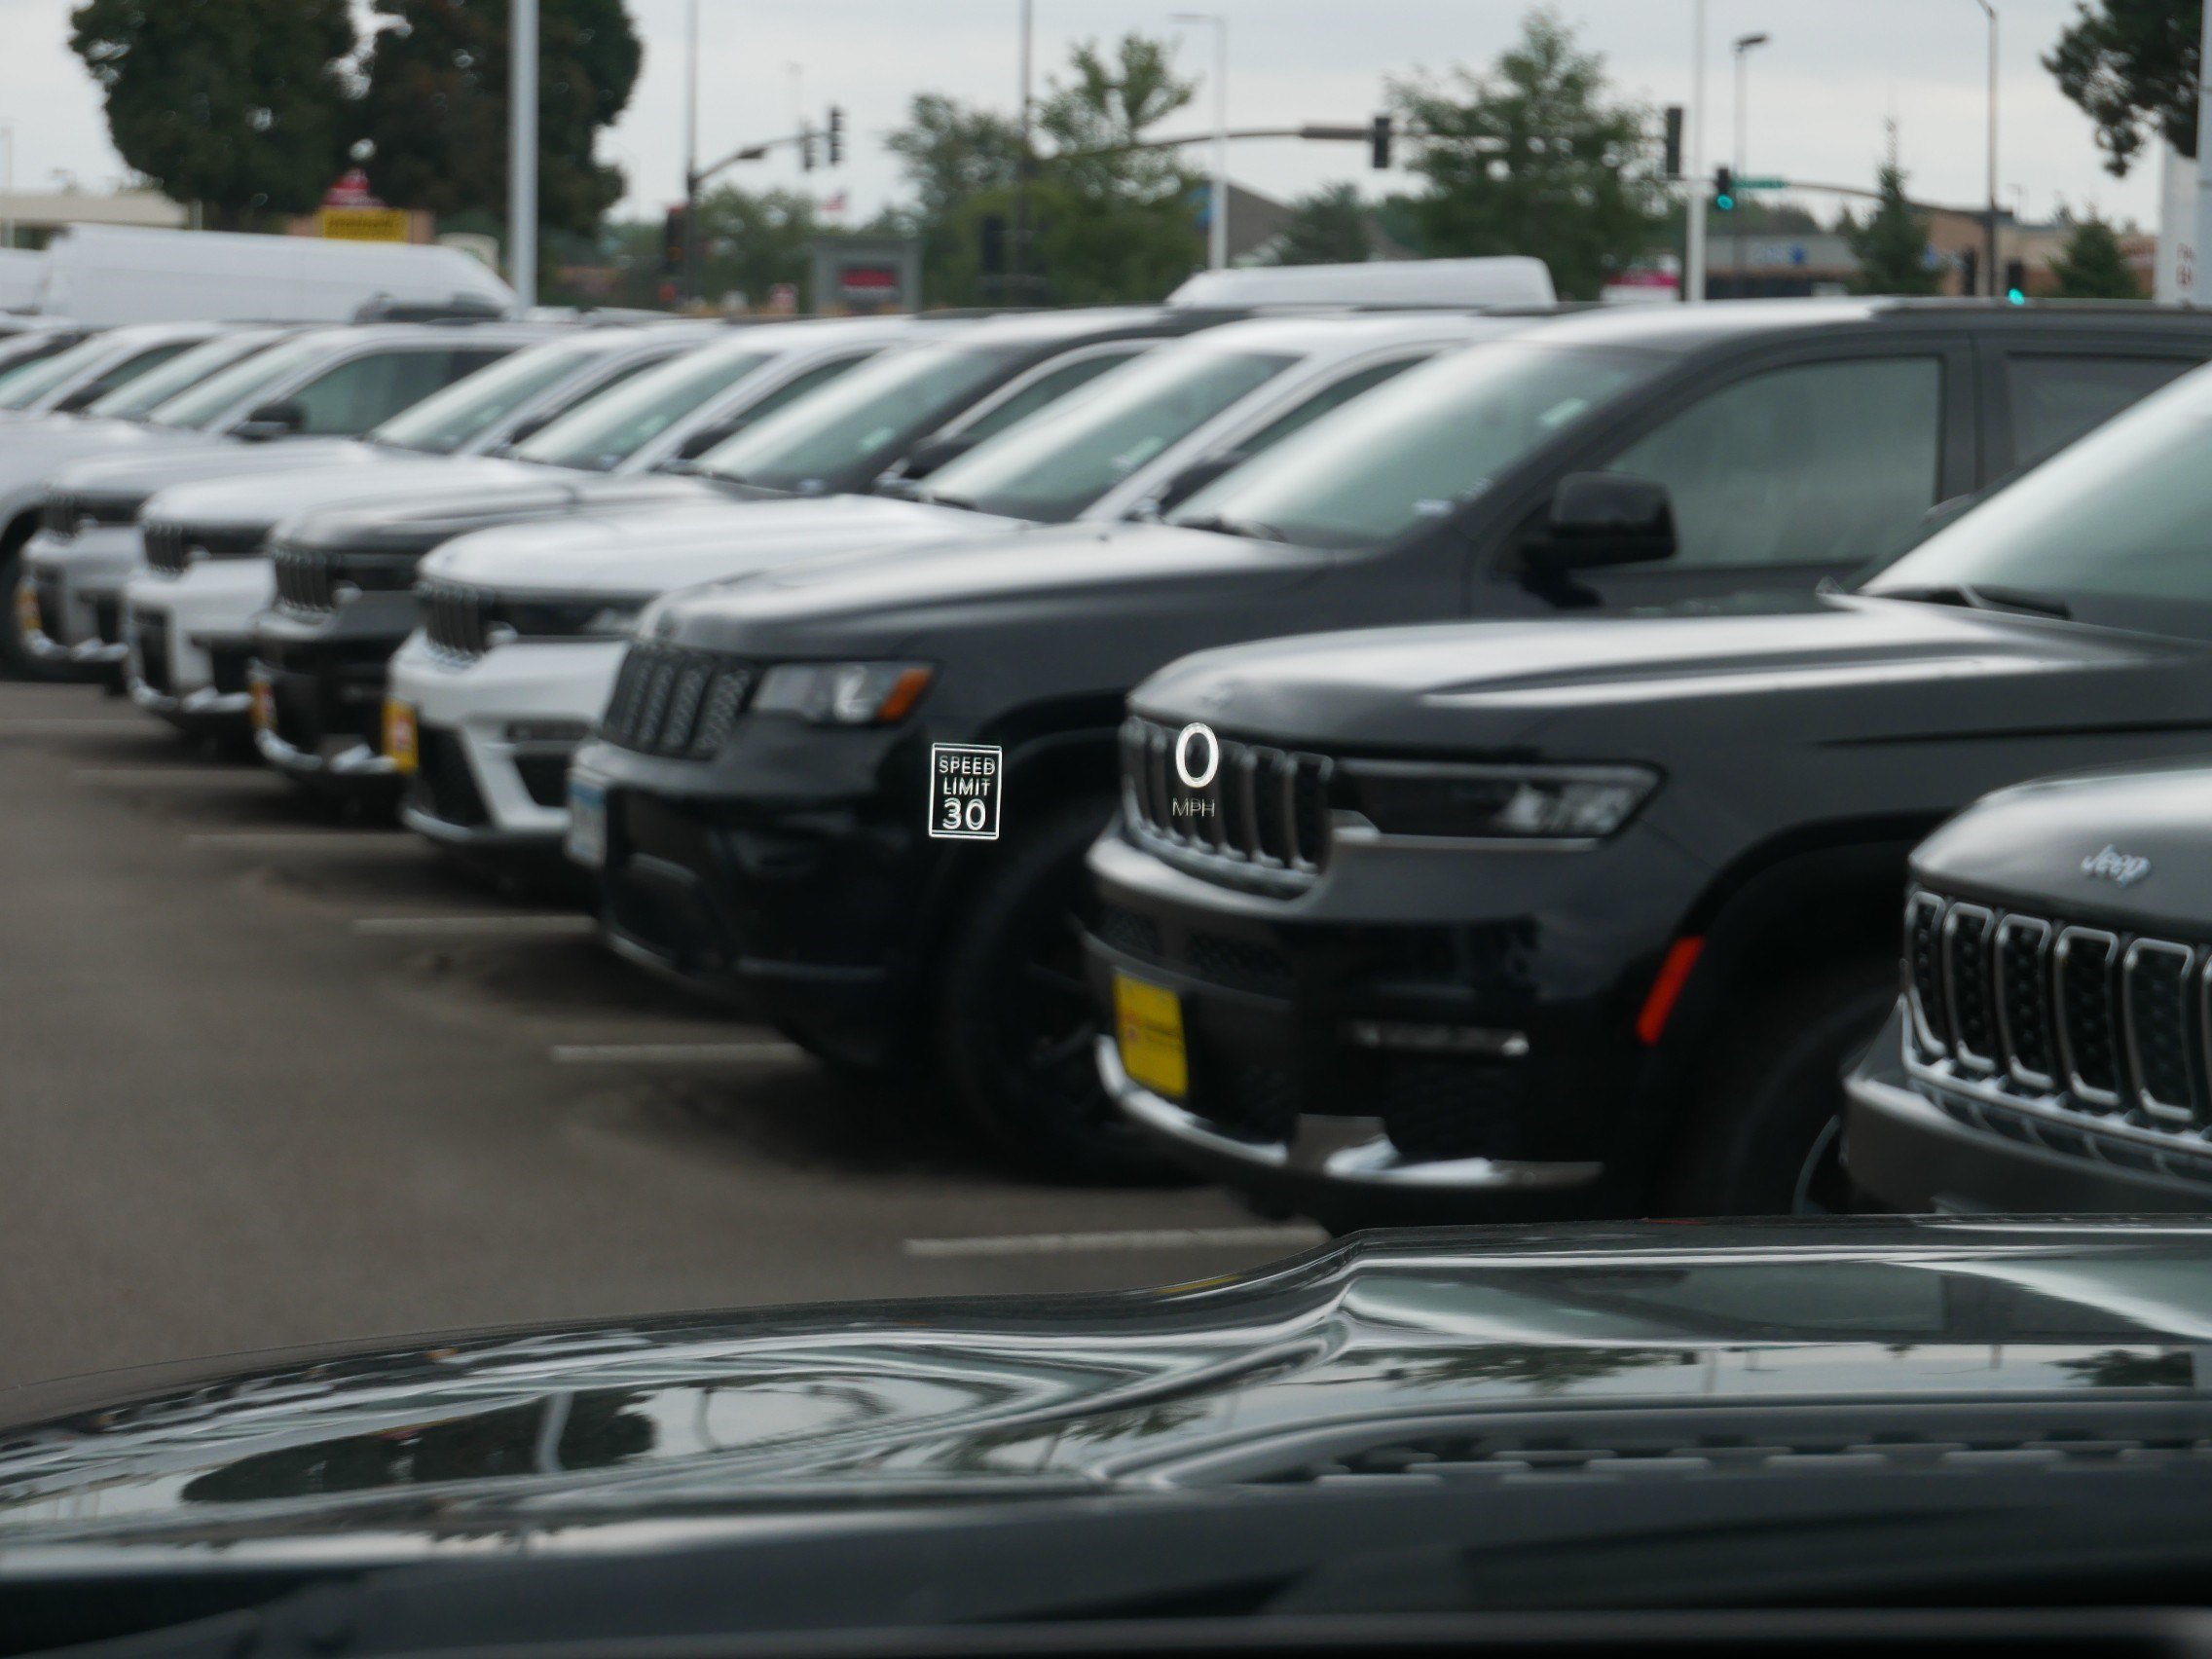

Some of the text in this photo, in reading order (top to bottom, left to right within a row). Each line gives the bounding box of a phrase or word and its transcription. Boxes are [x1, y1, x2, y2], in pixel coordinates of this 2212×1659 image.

[939, 756, 995, 775] SPEED
[1175, 721, 1219, 788] 0
[942, 778, 991, 796] LIMIT
[941, 798, 986, 830] 30
[1173, 797, 1215, 817] MPH
[2081, 844, 2151, 887] Jeep
